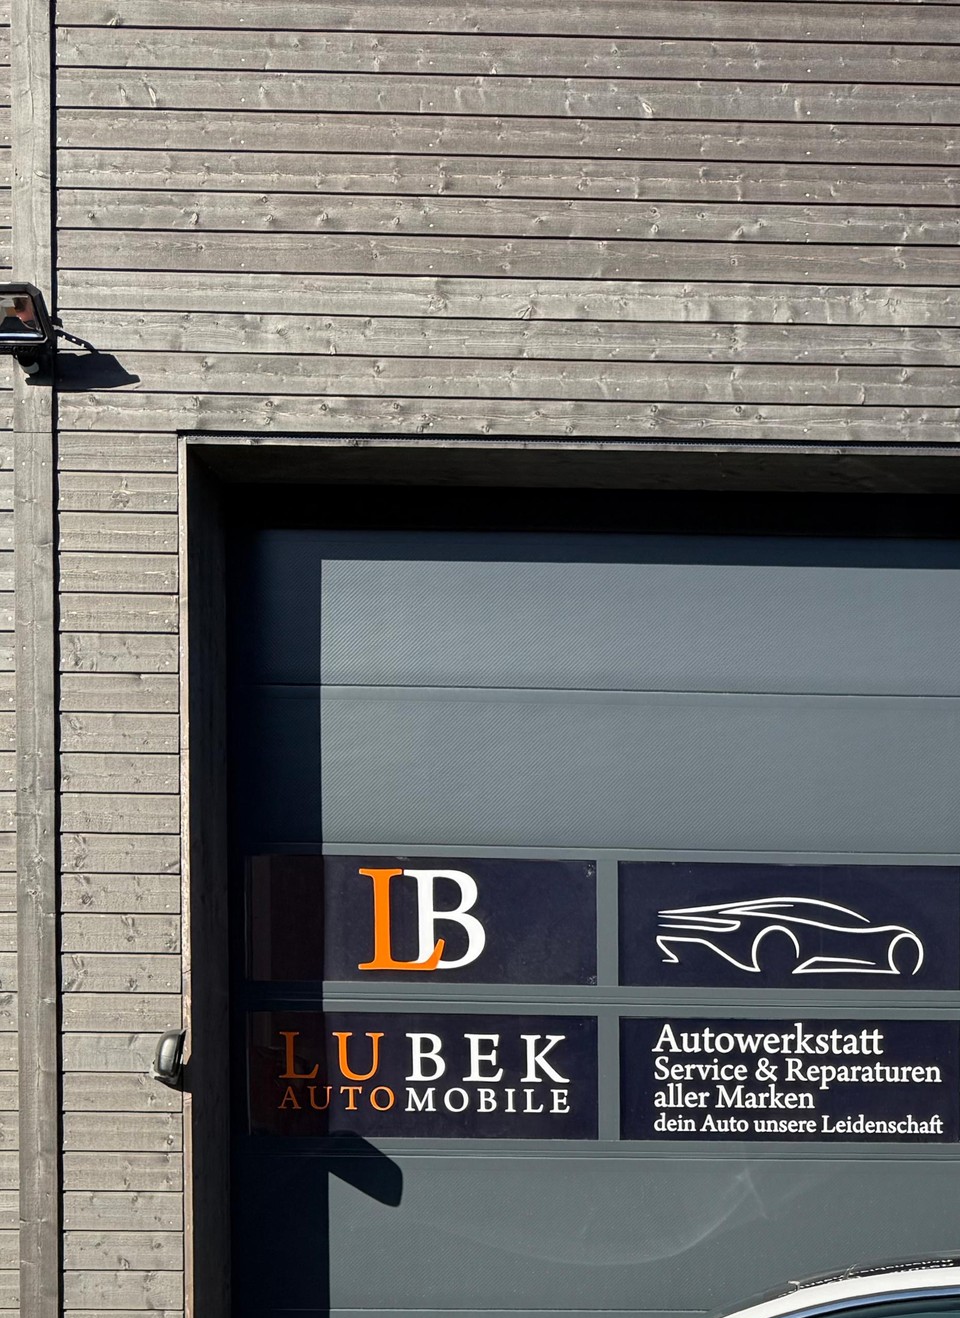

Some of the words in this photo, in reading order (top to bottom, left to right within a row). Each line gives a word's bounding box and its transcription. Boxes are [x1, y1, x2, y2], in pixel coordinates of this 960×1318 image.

[357, 867, 487, 972] LB
[651, 1023, 884, 1055] Autowerkstatt
[279, 1031, 571, 1084] LUBEK
[653, 1056, 748, 1082] Service
[754, 1058, 778, 1082] &
[784, 1058, 943, 1091] Reparaturen
[653, 1083, 710, 1109] aller
[714, 1084, 816, 1110] Marken
[653, 1113, 697, 1134] dein
[699, 1114, 749, 1134] Auto
[753, 1118, 817, 1134] unsere
[821, 1114, 944, 1135] Leidenschaft
